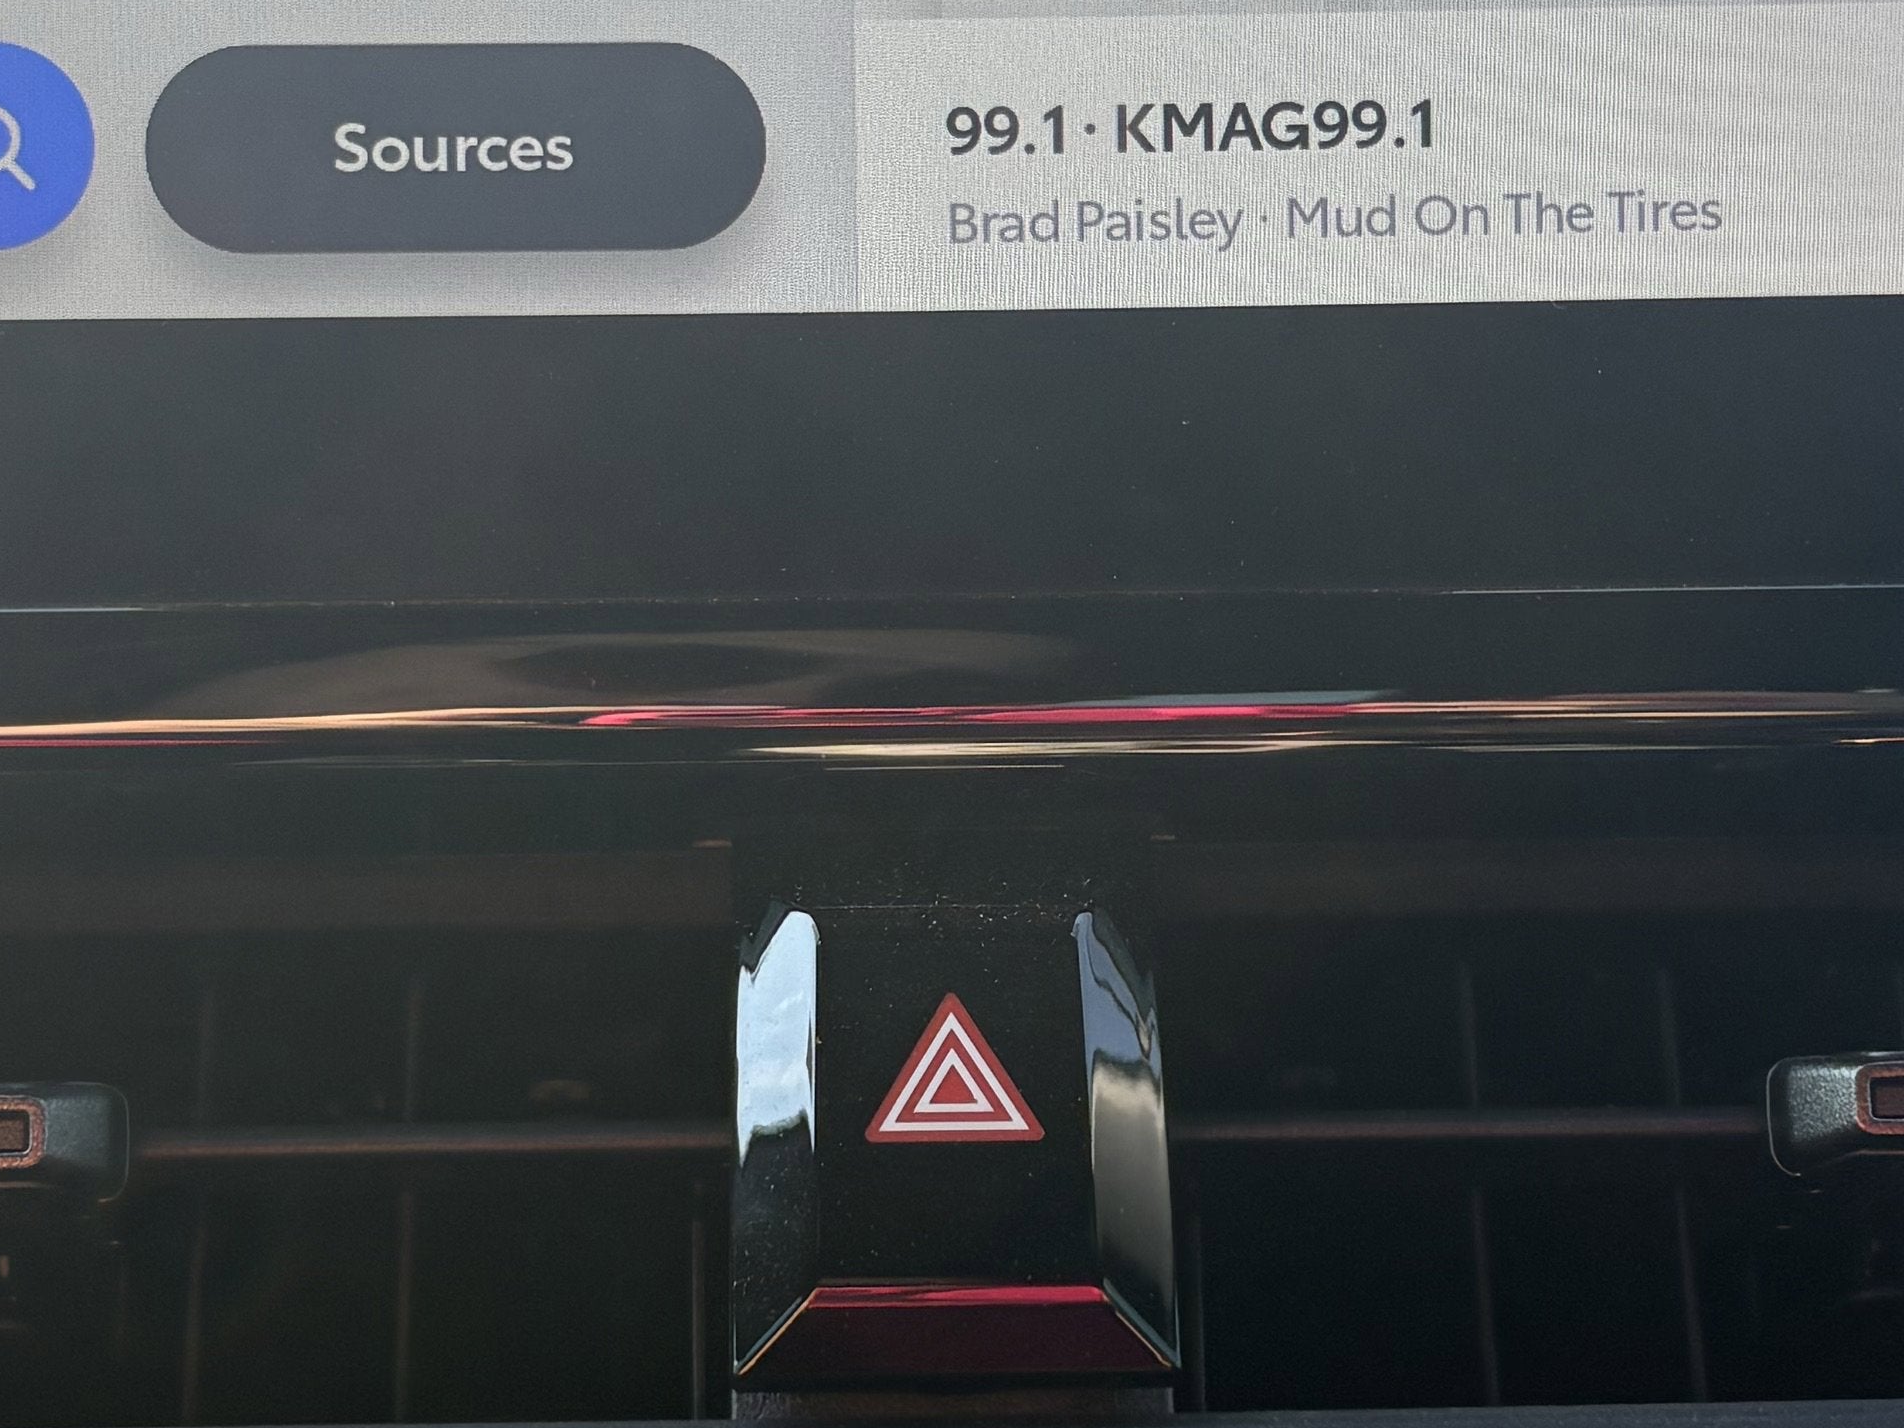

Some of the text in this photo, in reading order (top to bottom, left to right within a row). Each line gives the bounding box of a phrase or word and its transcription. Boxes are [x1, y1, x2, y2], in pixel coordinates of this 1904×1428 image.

[334, 122, 573, 173] Sources
[1116, 99, 1433, 153] KMAG99.1
[949, 188, 1723, 252] Brad Paisley Mud On The Tires
